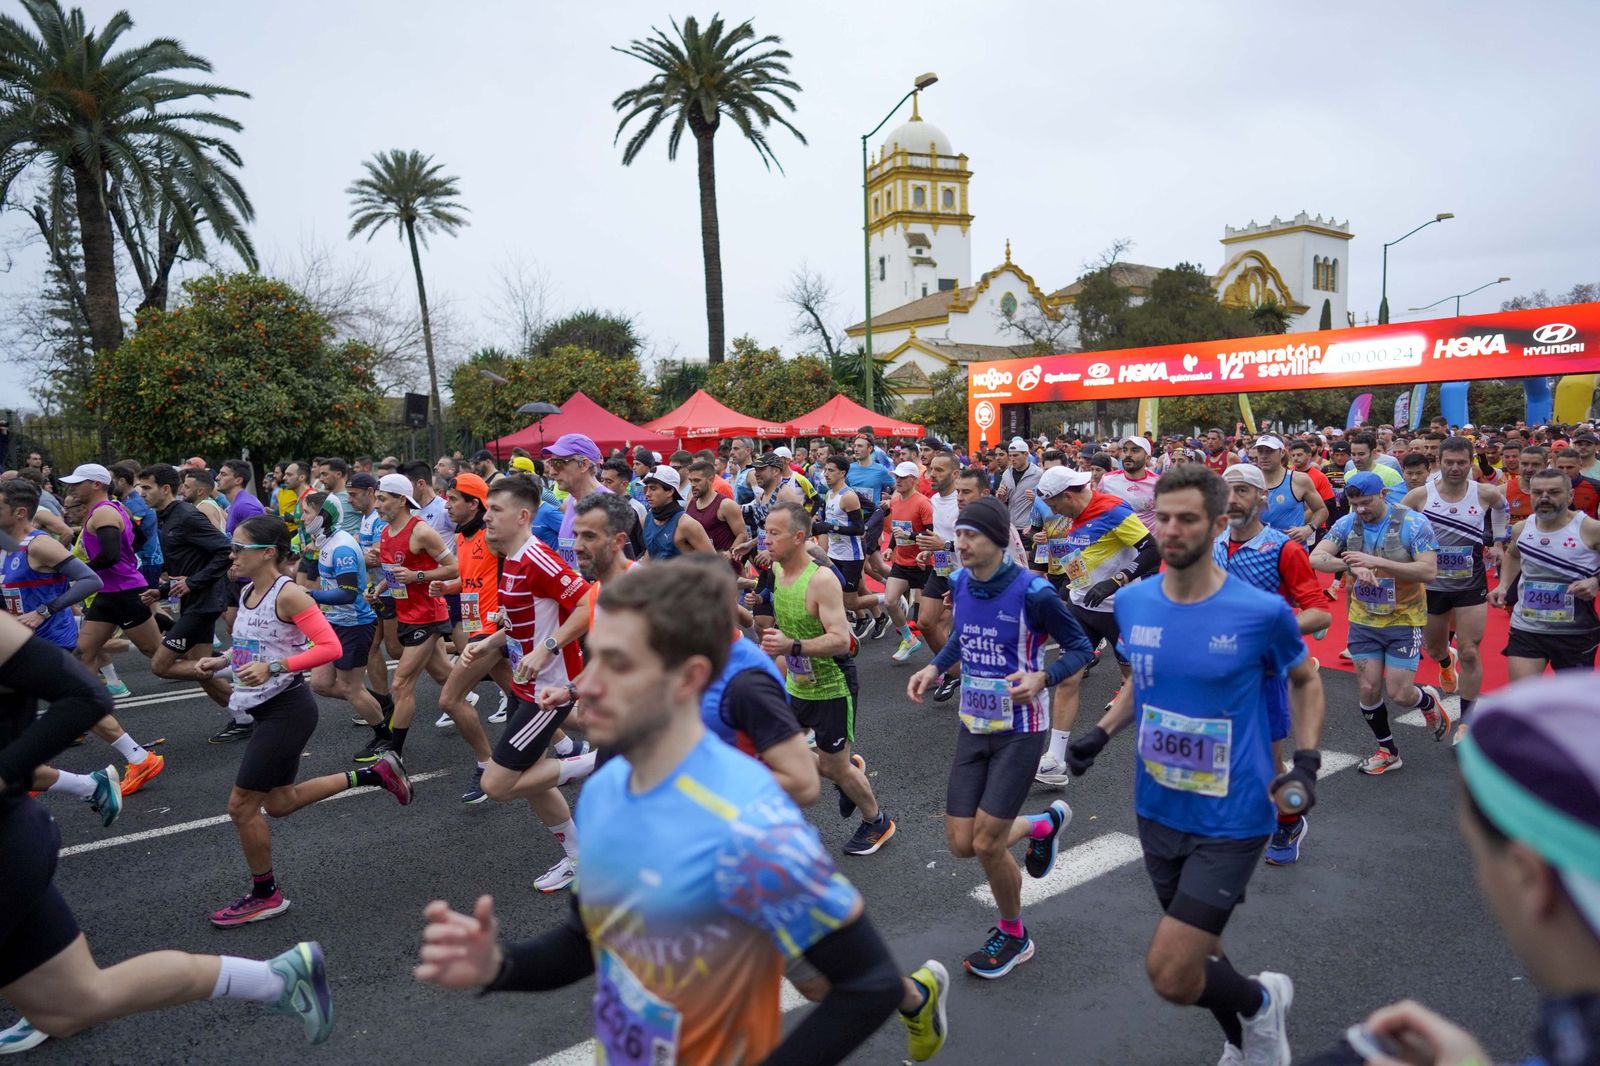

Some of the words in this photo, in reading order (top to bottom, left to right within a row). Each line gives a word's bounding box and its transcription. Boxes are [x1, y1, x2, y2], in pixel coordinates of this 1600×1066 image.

[1433, 333, 1509, 359] HOKA
[1523, 343, 1585, 356] HYUNDAI
[1341, 347, 1413, 365] 00:00:24
[1118, 361, 1169, 383] HOKA
[1257, 359, 1320, 378] sevilla
[1528, 591, 1561, 604] 2494
[966, 690, 997, 710] 3603
[1152, 730, 1204, 760] 3661
